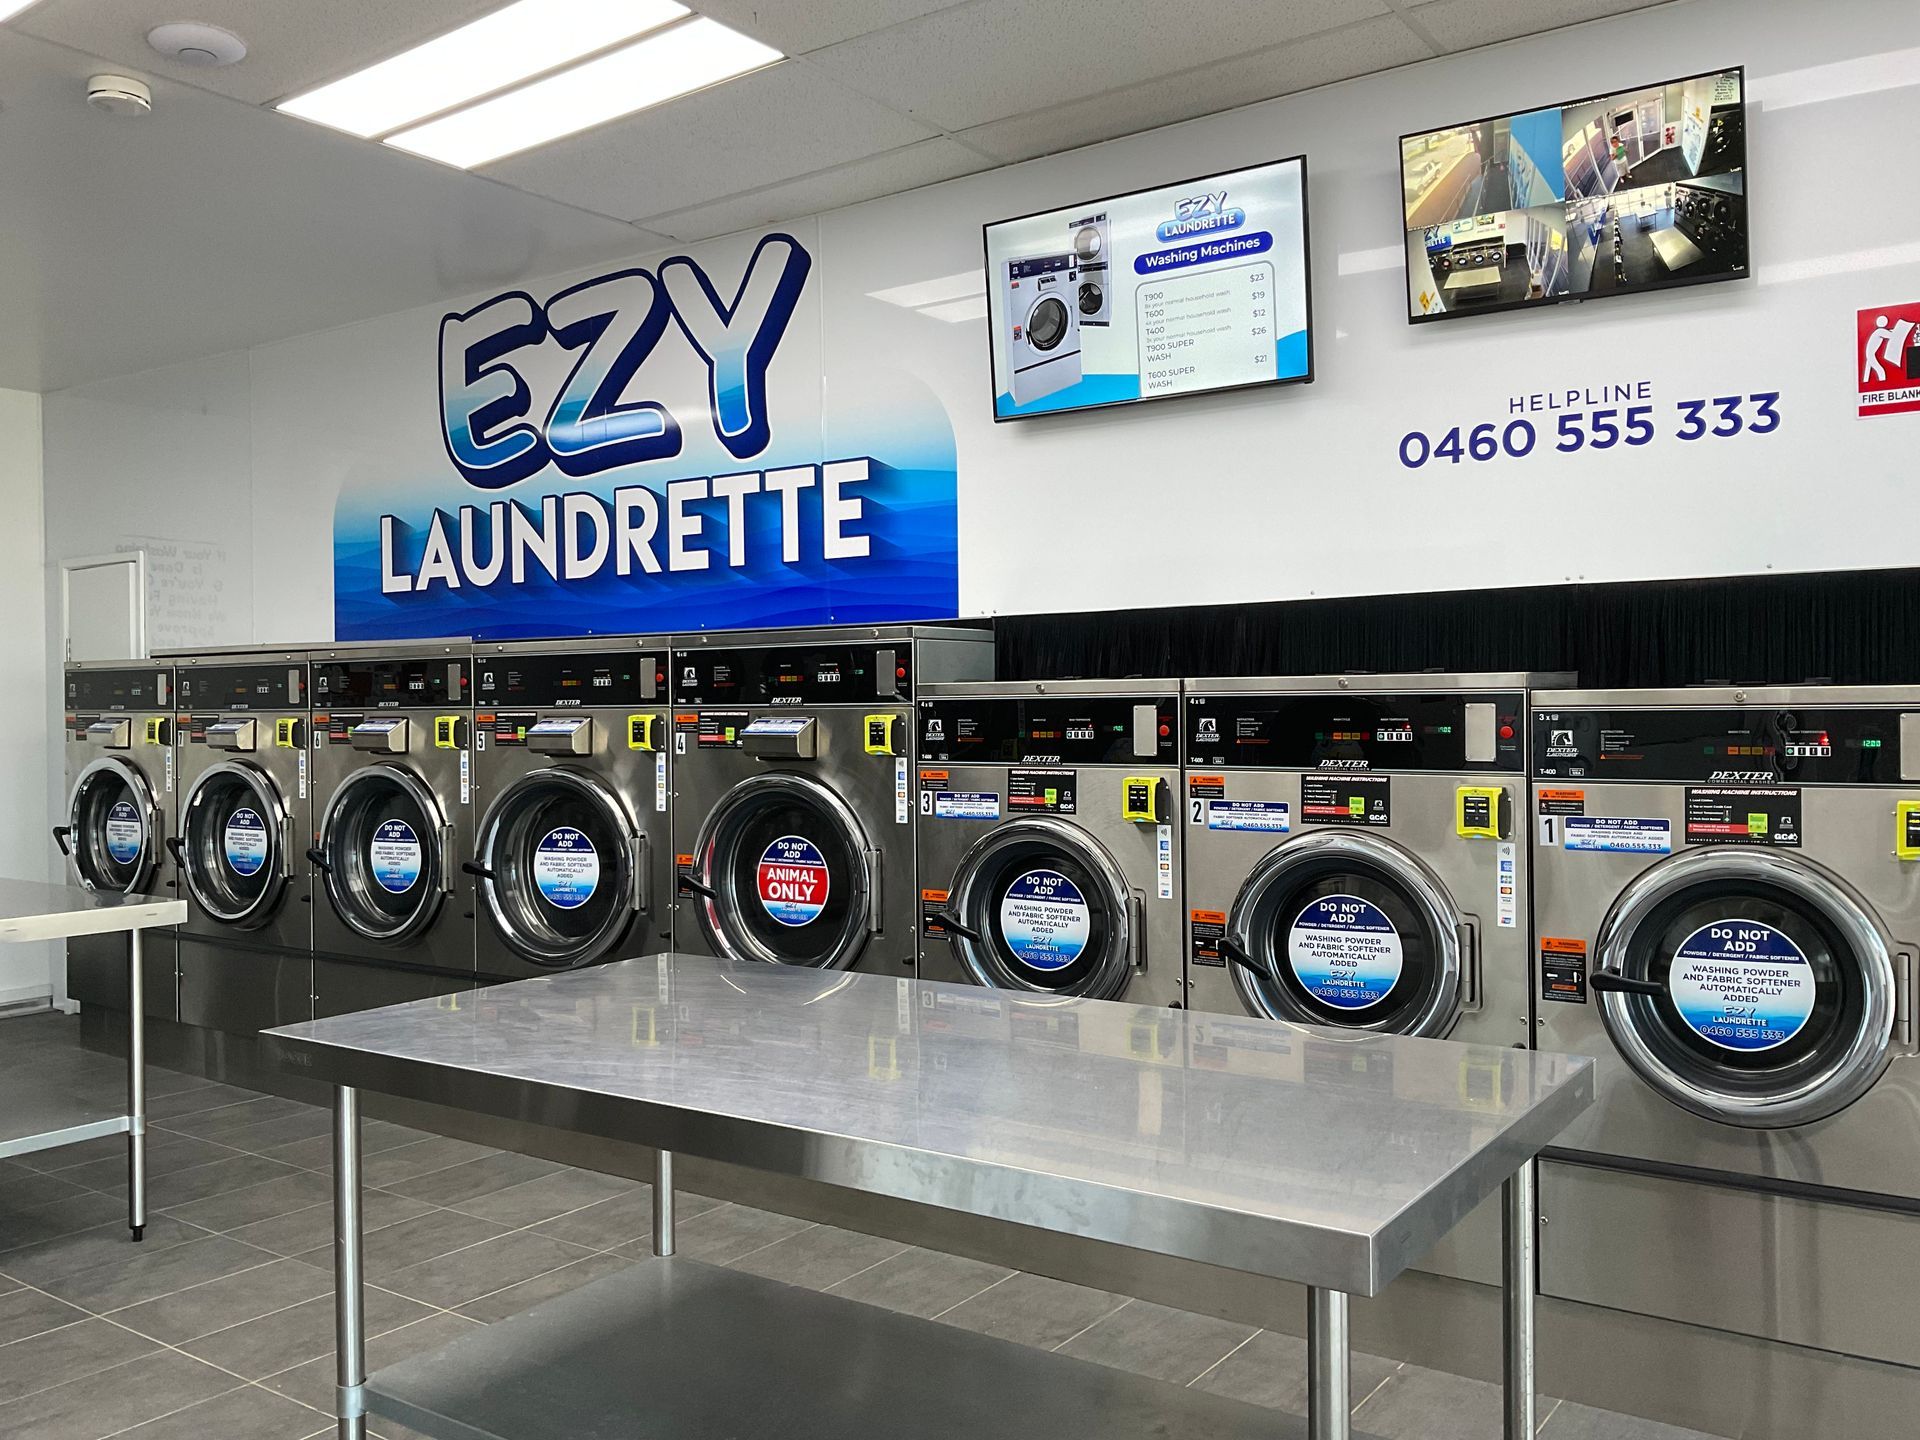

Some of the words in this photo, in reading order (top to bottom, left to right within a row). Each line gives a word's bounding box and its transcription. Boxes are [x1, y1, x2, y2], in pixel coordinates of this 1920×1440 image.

[1175, 191, 1227, 220] EZY
[1164, 213, 1235, 236] LAUNDRETTE
[1146, 250, 1198, 267] Washing
[1201, 239, 1260, 257] Machines
[1250, 274, 1264, 282] $23
[1145, 292, 1163, 301] T900
[1252, 291, 1265, 300] $19
[1145, 309, 1164, 318] T600
[1186, 310, 1216, 319] household
[1253, 309, 1266, 318] $12
[1146, 327, 1165, 335] T400
[1252, 327, 1266, 336] $26
[1147, 344, 1165, 352] T900
[1167, 339, 1194, 349] SUPER
[438, 232, 813, 490] EZY
[1147, 353, 1171, 362] WASH
[1254, 355, 1267, 363] $21
[1148, 371, 1166, 379] T600
[1168, 366, 1195, 376] SUPER
[1148, 380, 1172, 389] WASH
[1509, 381, 1652, 415] HELPLINE
[1862, 393, 1885, 403] FIRE
[1399, 418, 1536, 469] 0460
[1555, 405, 1655, 453] 555
[1674, 391, 1781, 441] 333
[379, 455, 873, 595] LAUNDRETTE
[315, 733, 320, 747] 6
[478, 733, 483, 749] 5
[678, 735, 683, 752] 4
[1710, 772, 1774, 780] DEXTER
[923, 793, 930, 812] 3
[1193, 801, 1202, 822] 2
[1544, 818, 1553, 843] 1
[767, 868, 818, 883] ANIMAL
[1043, 878, 1063, 886] NOT
[768, 882, 814, 901] ONLY
[1033, 886, 1053, 894] ADD
[1014, 904, 1042, 912] WASHING
[1320, 903, 1337, 911] DO
[1342, 904, 1366, 913] NOT
[1018, 919, 1068, 928] AUTOMATICALLY
[1330, 914, 1355, 923] ADD
[1305, 934, 1342, 943] WASHING
[1345, 937, 1381, 945] POWDER
[1711, 928, 1733, 939] DO
[1739, 929, 1770, 941] NOT
[1317, 943, 1345, 951] FABRIC
[1724, 941, 1756, 952] ADD
[1311, 951, 1377, 961] AUTOMATICALLY
[1692, 965, 1739, 975] WASHING
[1743, 968, 1789, 977] POWDER
[1322, 979, 1365, 987] LAUNDRETTE
[1682, 973, 1704, 981] AND
[1707, 975, 1742, 984] FABRIC
[1747, 977, 1800, 987] SOFTENER
[1313, 987, 1339, 996] 0460
[1341, 990, 1359, 998] 555
[1700, 983, 1783, 996] AUTOMATICALLY
[1723, 994, 1759, 1003] ADDED
[1723, 1005, 1756, 1019] EZY
[1713, 1015, 1767, 1026] LAUNDRETTE
[1700, 1025, 1733, 1035] 0460
[1736, 1027, 1758, 1038] 555
[1762, 1029, 1785, 1040] 333
